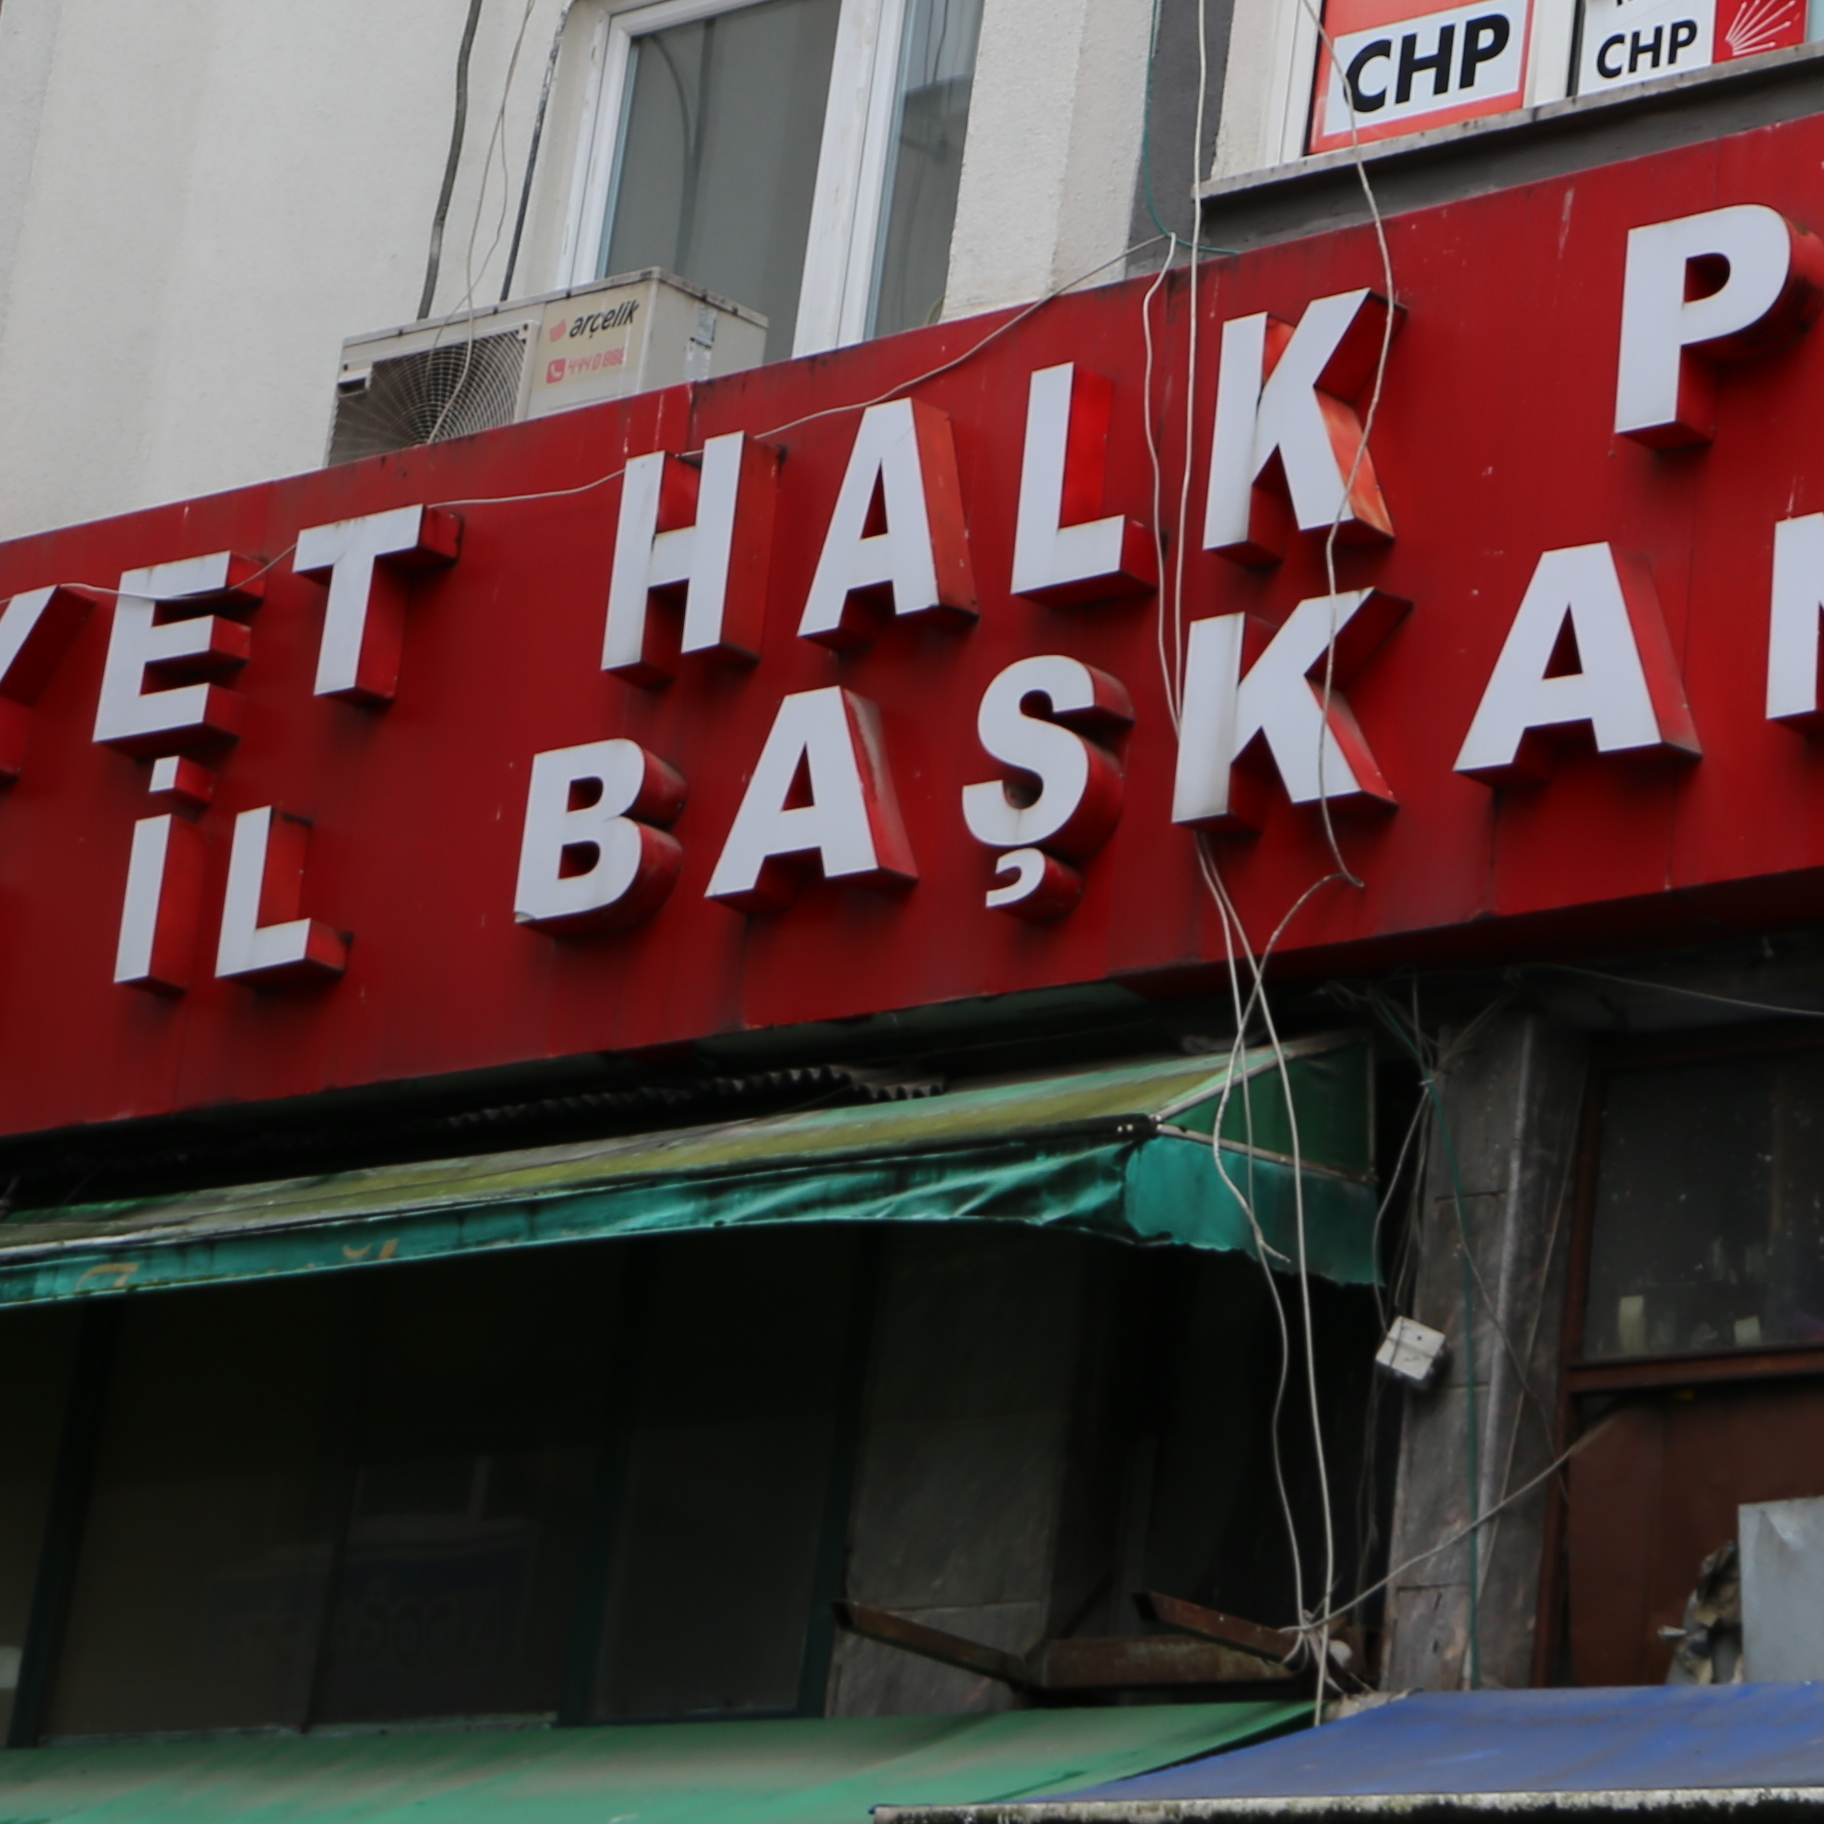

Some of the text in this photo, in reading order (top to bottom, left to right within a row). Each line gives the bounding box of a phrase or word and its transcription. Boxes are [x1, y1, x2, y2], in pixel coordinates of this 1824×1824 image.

[1343, 13, 1511, 113] CHP
[1596, 19, 1698, 80] CHP
[569, 299, 640, 339] arçelik
[602, 288, 1371, 671] HALK
[114, 755, 312, 984] İL
